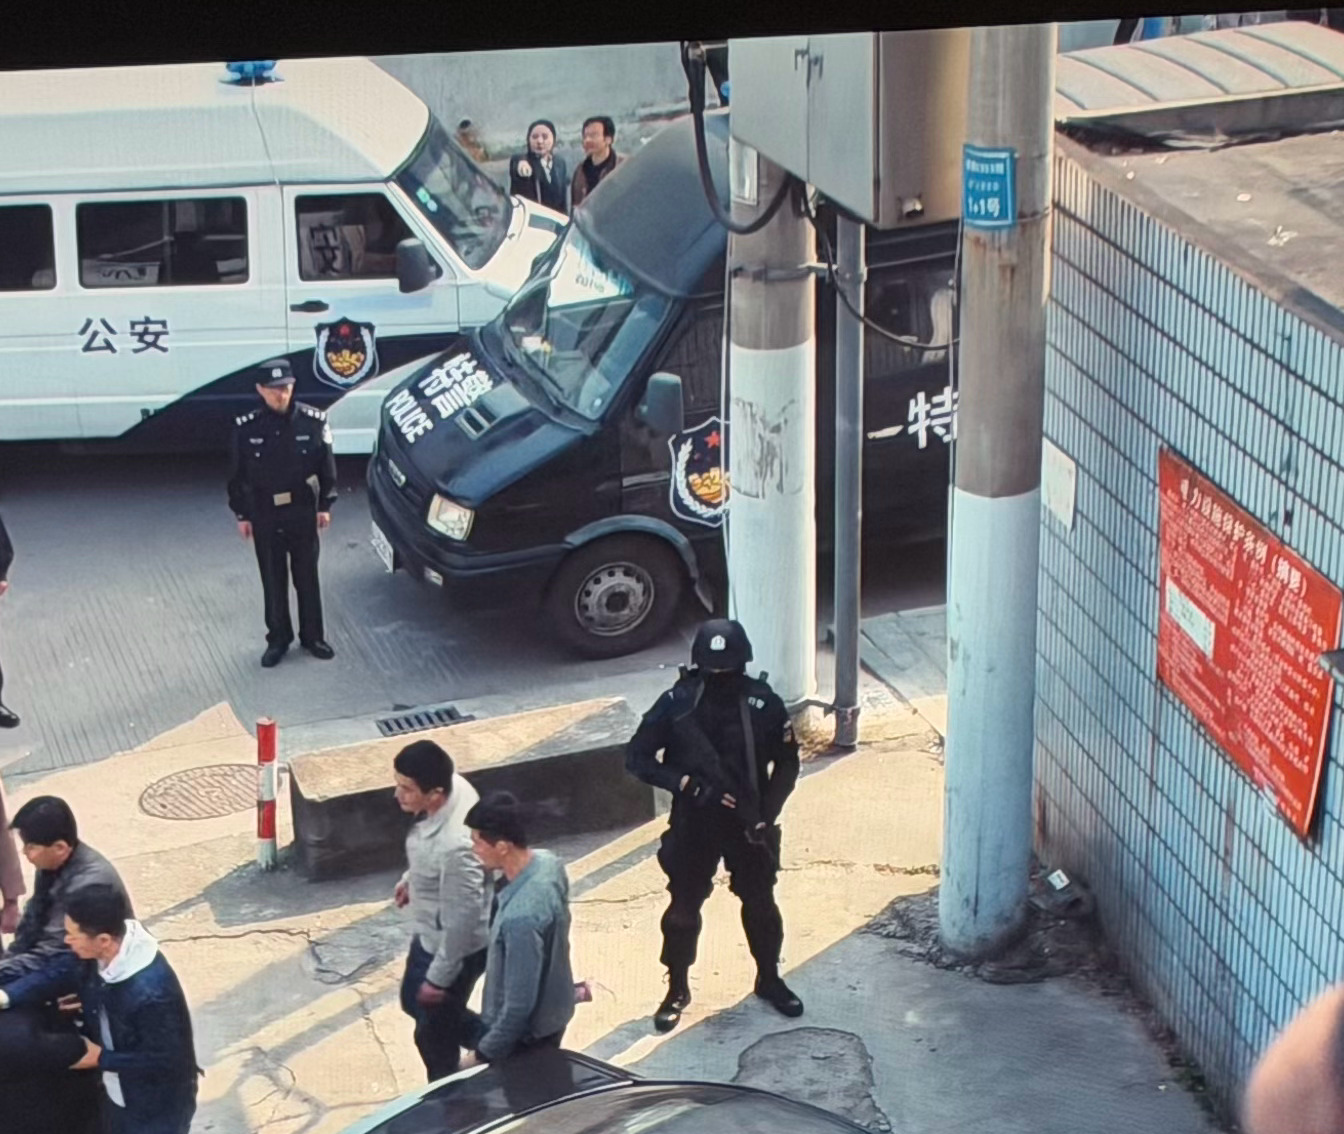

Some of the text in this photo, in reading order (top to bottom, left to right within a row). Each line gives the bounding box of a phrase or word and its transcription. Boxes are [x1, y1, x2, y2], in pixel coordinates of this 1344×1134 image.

[77, 315, 170, 354] 公安
[417, 351, 494, 420] 特警
[384, 388, 434, 444] POLICE
